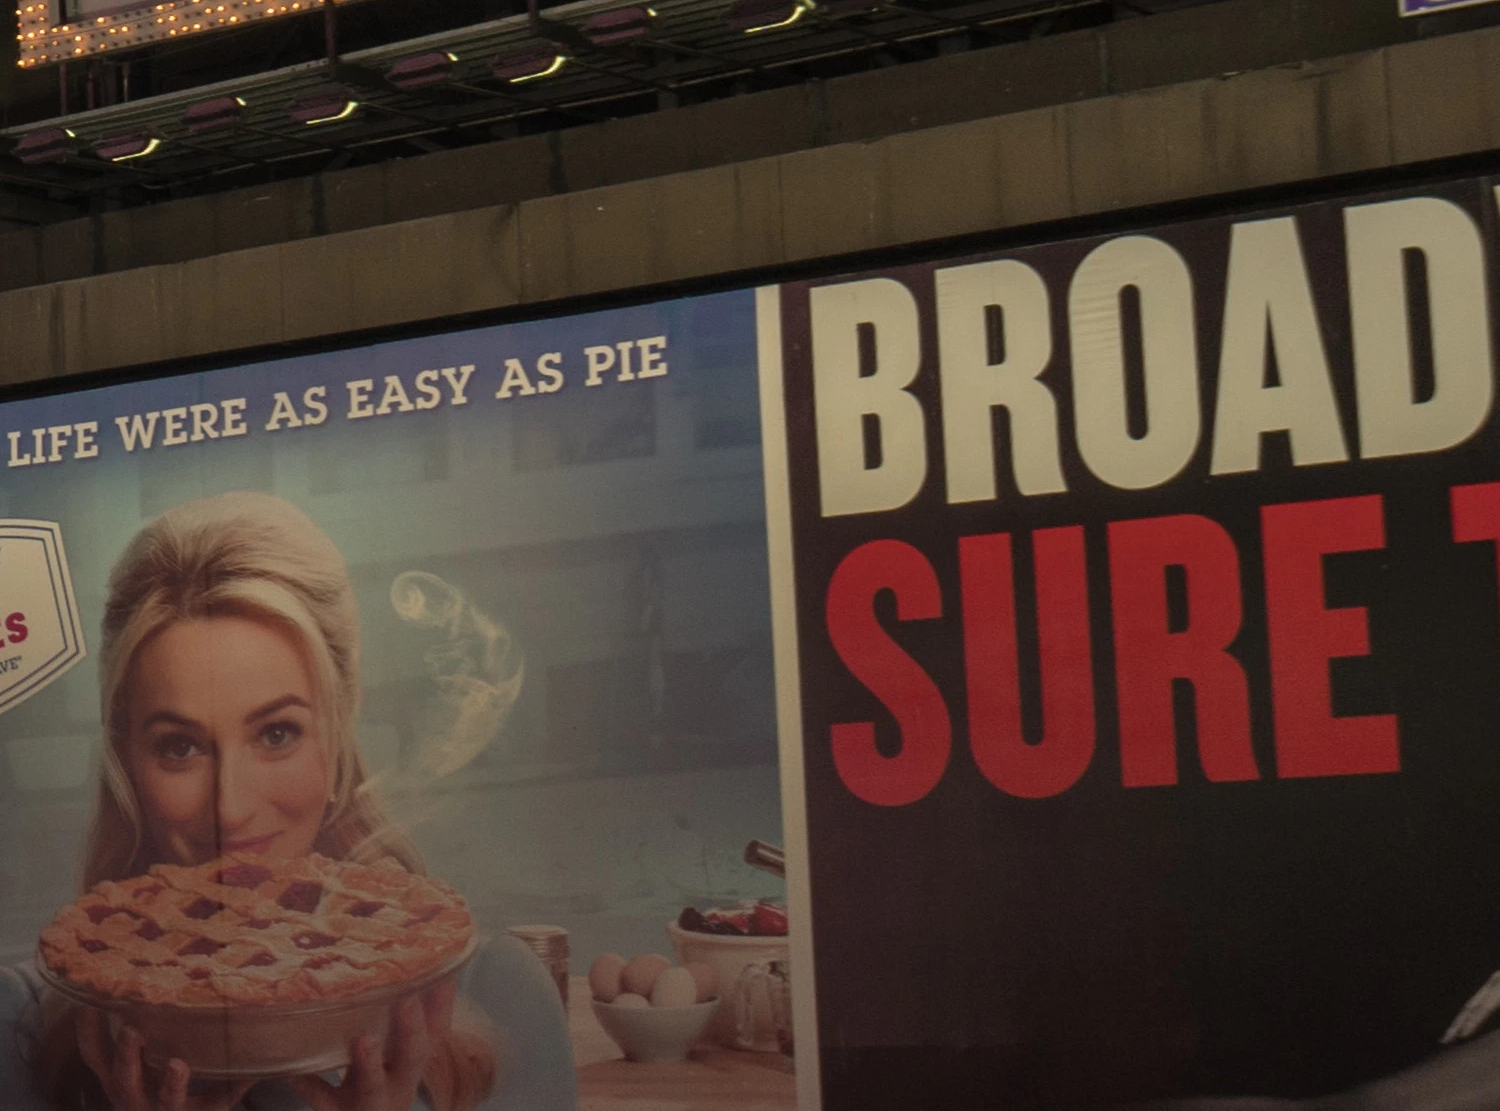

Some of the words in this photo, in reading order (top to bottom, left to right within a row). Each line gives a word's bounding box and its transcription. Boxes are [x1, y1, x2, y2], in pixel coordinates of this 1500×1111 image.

[7, 420, 98, 469] LIFE
[115, 397, 246, 453] WERE
[265, 385, 328, 432] AS
[346, 364, 476, 422] EASY
[497, 351, 563, 399] AS
[584, 335, 669, 387] PIE
[809, 189, 1500, 518] BROAD
[825, 495, 1401, 807] SURE
